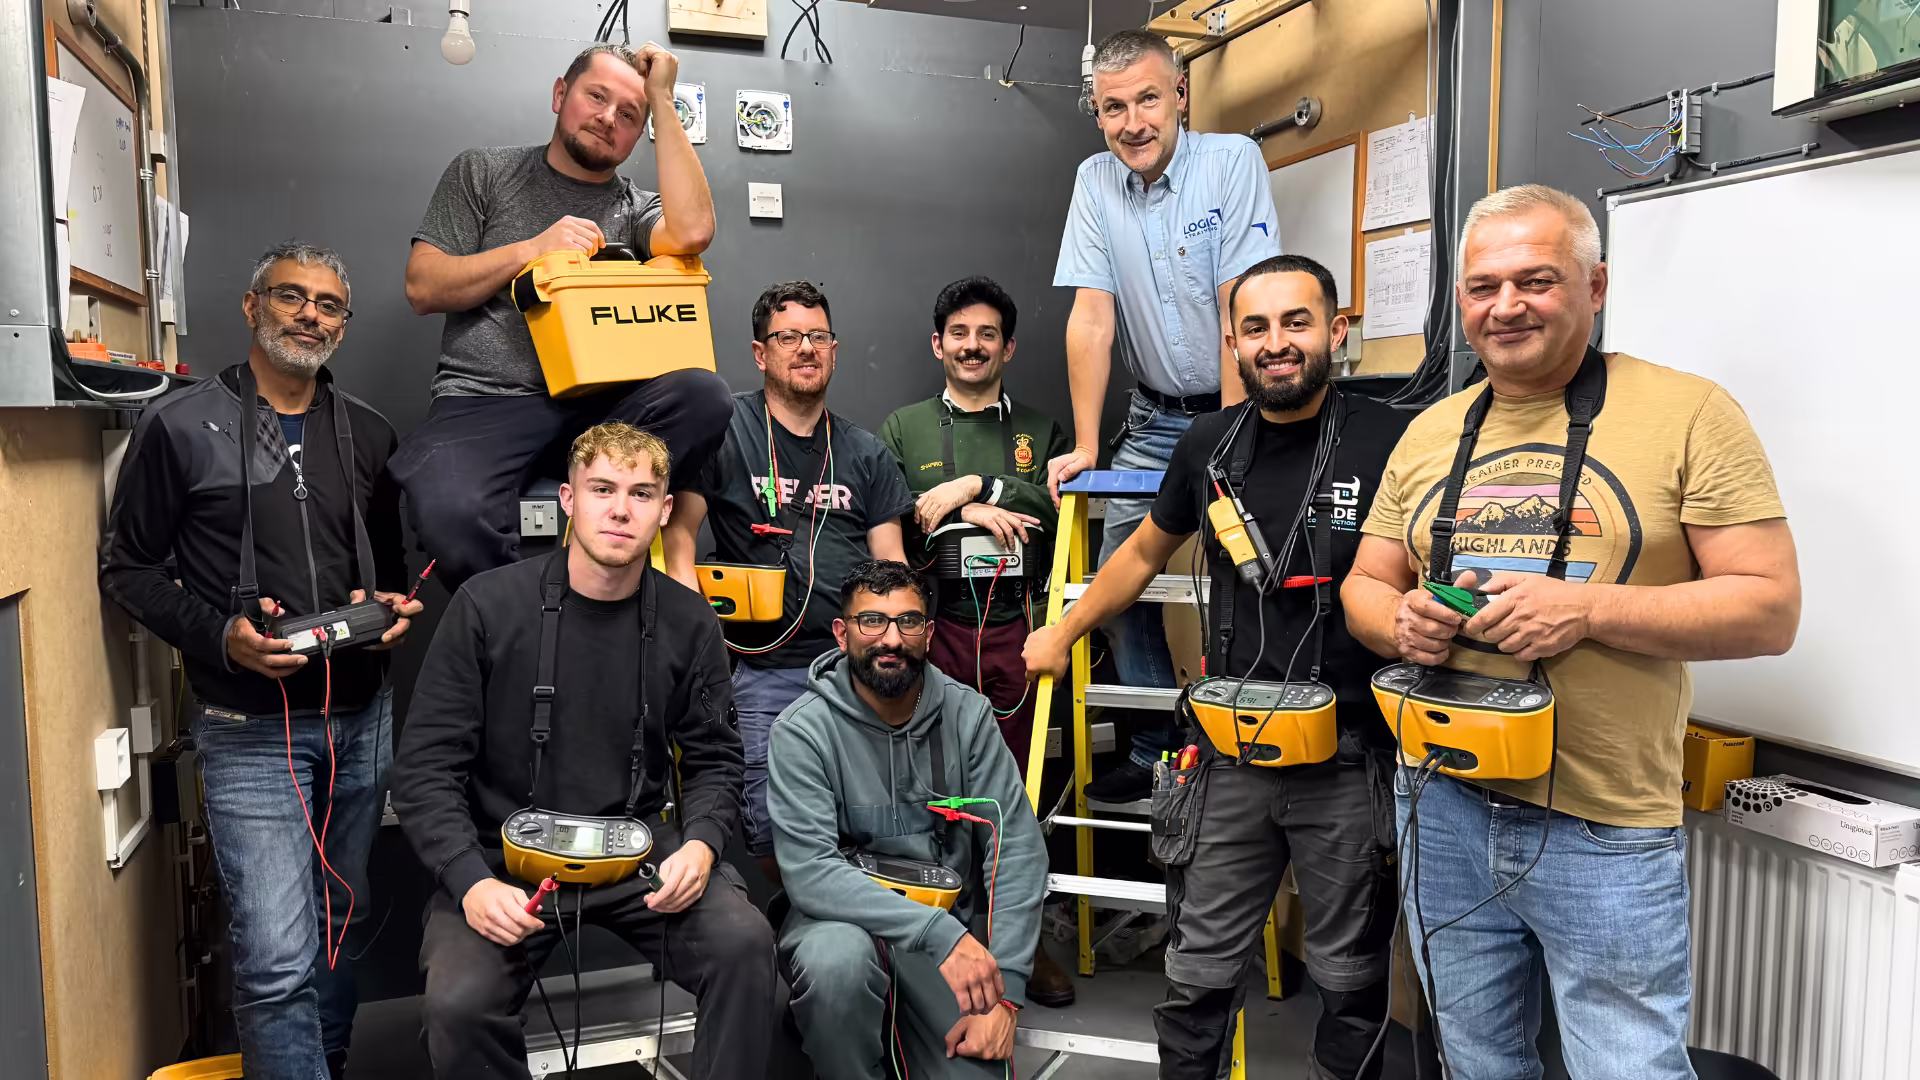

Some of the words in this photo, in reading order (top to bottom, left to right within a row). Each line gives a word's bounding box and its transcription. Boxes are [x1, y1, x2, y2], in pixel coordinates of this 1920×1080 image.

[1184, 215, 1217, 235] LOGIC
[590, 303, 698, 326] FLUKE
[1526, 458, 1592, 485] PREPD
[1307, 505, 1357, 521] MDE
[1307, 517, 1357, 527] COUCTION
[1452, 536, 1572, 557] HIGHLANDS
